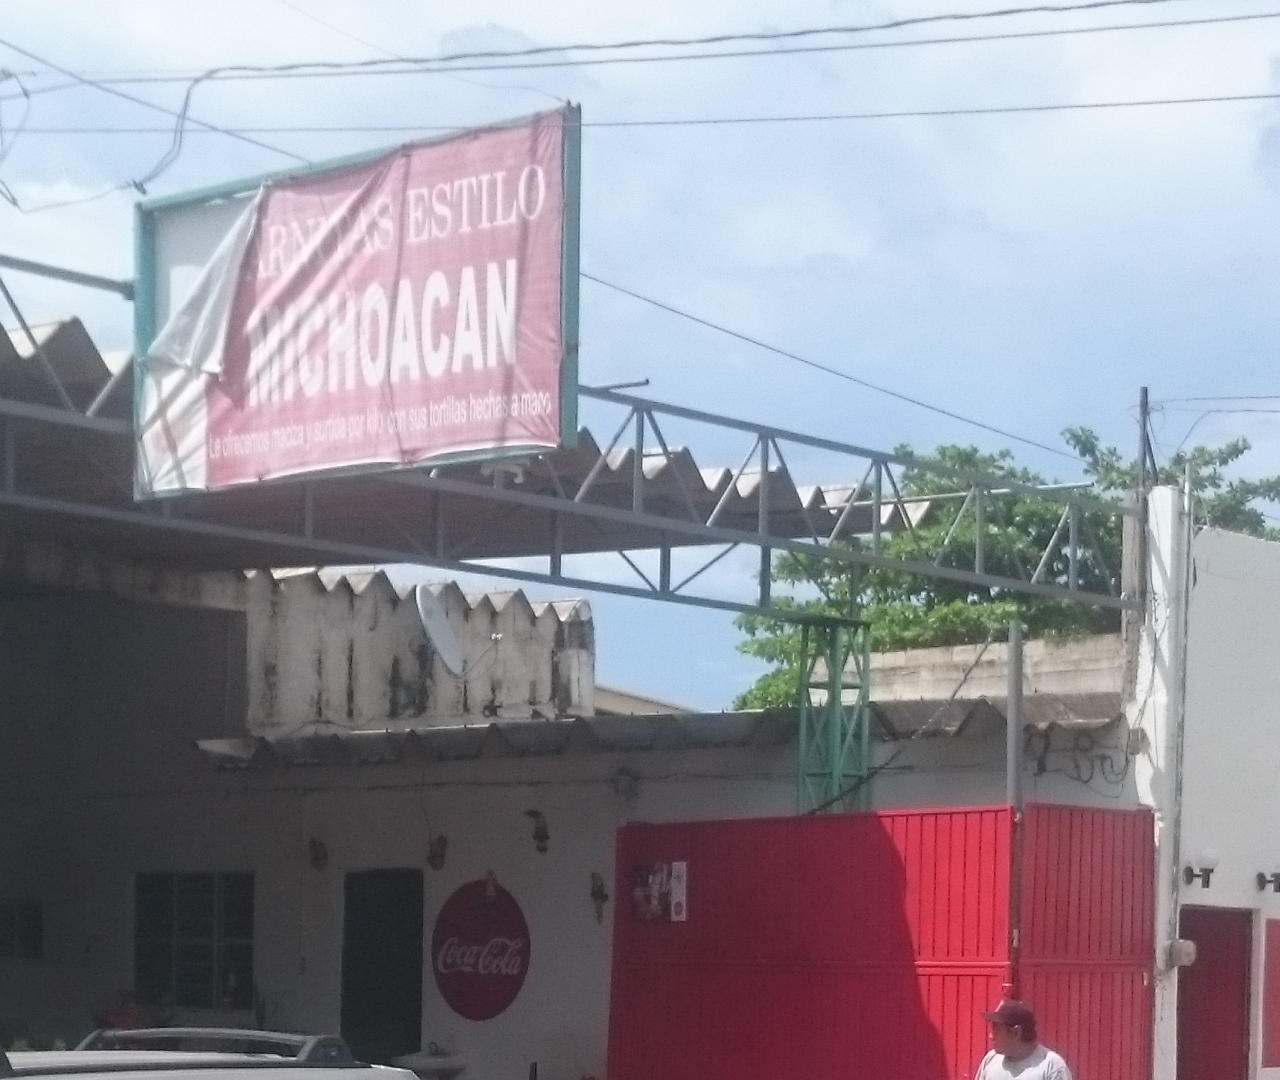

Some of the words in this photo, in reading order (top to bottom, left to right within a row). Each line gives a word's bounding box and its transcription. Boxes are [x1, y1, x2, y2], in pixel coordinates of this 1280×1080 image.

[407, 164, 545, 244] ESTILO
[245, 259, 518, 407] MICHOACAN
[209, 434, 221, 459] Le
[222, 429, 269, 457] ofrecemos
[348, 414, 365, 443] por
[387, 409, 406, 434] con
[409, 406, 427, 430] sus
[430, 395, 466, 427] tortillas
[469, 389, 508, 420] hechas
[510, 394, 518, 417] a
